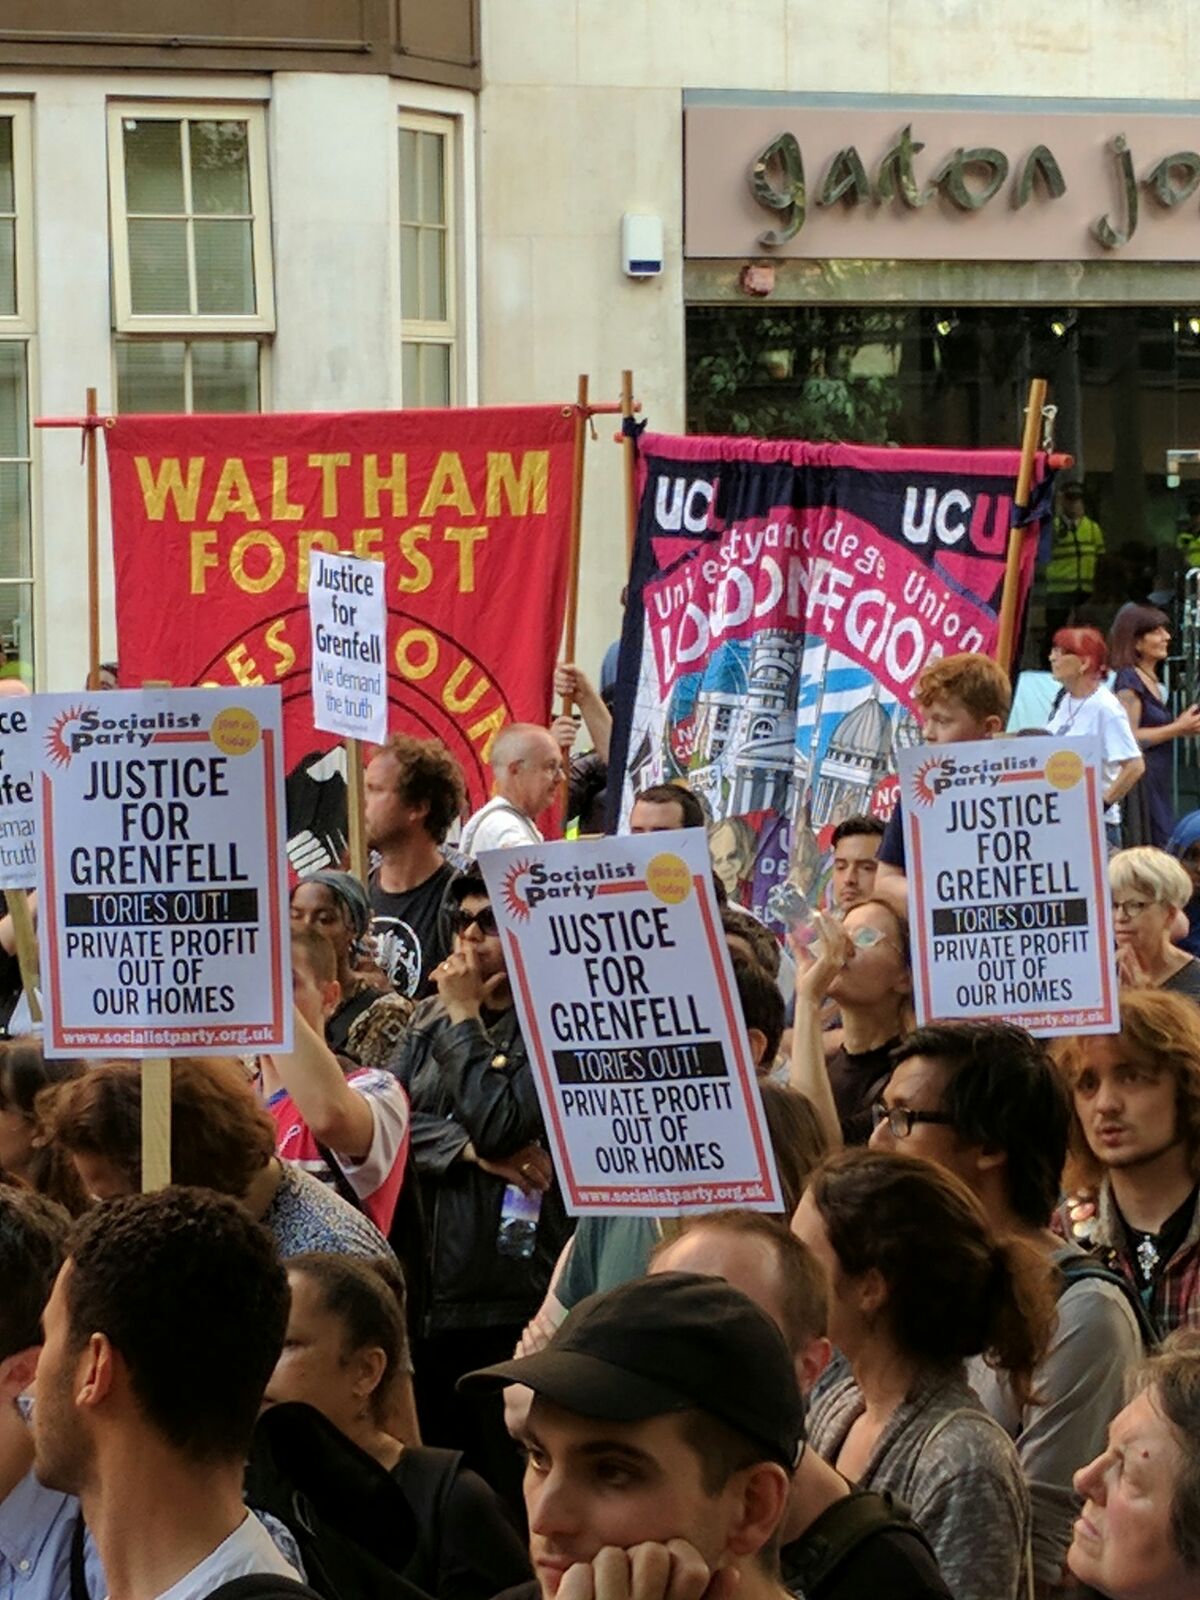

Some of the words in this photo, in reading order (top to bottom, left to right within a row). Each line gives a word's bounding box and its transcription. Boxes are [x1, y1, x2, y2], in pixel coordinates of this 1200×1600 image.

[133, 450, 550, 522] WALTHAM
[903, 486, 1012, 554] UCU
[317, 559, 374, 596] Justice
[332, 595, 357, 626] for
[904, 571, 984, 653] Union
[316, 624, 381, 664] Grenfell
[318, 662, 333, 685] We
[336, 666, 381, 695] demand
[80, 710, 201, 731] Socialist
[326, 691, 342, 713] the
[344, 696, 373, 719] truth
[83, 757, 228, 800] JUSTICE
[940, 756, 1037, 776] Socialist
[121, 802, 190, 841] FOR
[946, 792, 1060, 834] JUSTICE
[977, 831, 1031, 864] FOR
[70, 843, 248, 886] GRENFELL
[529, 862, 636, 885] Socialist
[936, 861, 1078, 902] GRENFELL
[89, 893, 167, 924] TORIES
[174, 892, 229, 923] OUT!
[952, 908, 1016, 934] TORIES
[1021, 904, 1067, 929] OUT!
[67, 931, 163, 958] PRIVATE
[171, 928, 259, 955] PROFIT
[549, 908, 675, 956] JUSTICE
[934, 937, 1014, 962] PRIVATE
[1021, 930, 1089, 955] PROFIT
[118, 960, 164, 986] OUT
[173, 958, 202, 985] OF
[585, 955, 649, 997] FOR
[978, 960, 1015, 982] OUT
[1022, 957, 1047, 980] OF
[93, 988, 138, 1014] OUR
[147, 986, 235, 1014] HOMES
[957, 984, 996, 1007] OUR
[1002, 979, 1073, 1004] HOMES
[551, 995, 711, 1043] GRENFELL
[63, 1027, 273, 1046] www.socialistparty.org.uk
[574, 1052, 647, 1081] TORIES
[649, 1048, 703, 1078] OUT!
[562, 1088, 649, 1117] PRIVATE
[651, 1082, 733, 1112] PROFIT
[613, 1118, 652, 1145] OUT
[660, 1115, 688, 1142] OF
[596, 1146, 639, 1174] OUR
[643, 1143, 724, 1172] HOMES
[578, 1184, 765, 1205] www.socialistparty.org.uk
